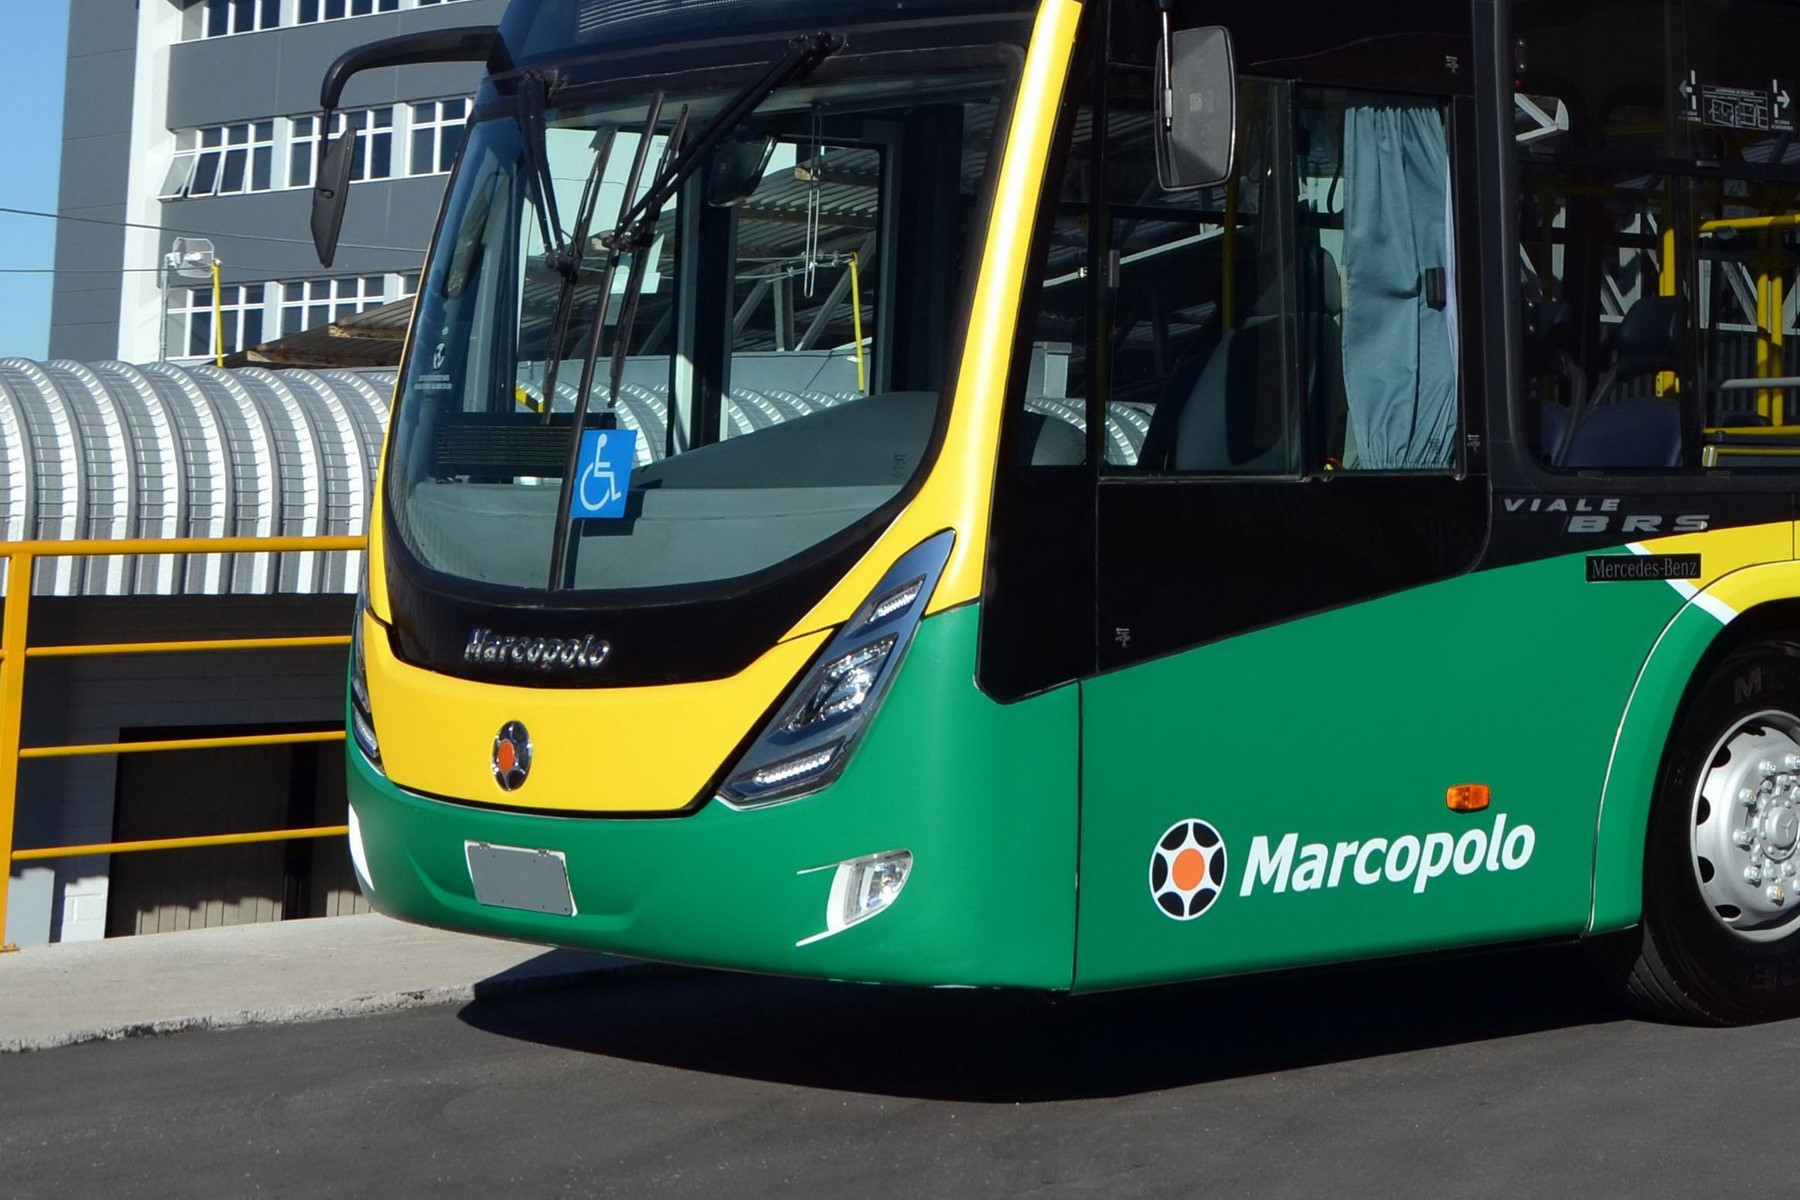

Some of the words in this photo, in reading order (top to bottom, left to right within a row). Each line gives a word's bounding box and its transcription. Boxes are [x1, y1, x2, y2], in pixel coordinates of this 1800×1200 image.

[1503, 498, 1621, 513] VIALE
[1567, 514, 1711, 533] BRS
[1592, 557, 1698, 579] Mercedes-Benz
[464, 628, 611, 671] Marcopolo
[1239, 813, 1536, 897] Marcopolo
